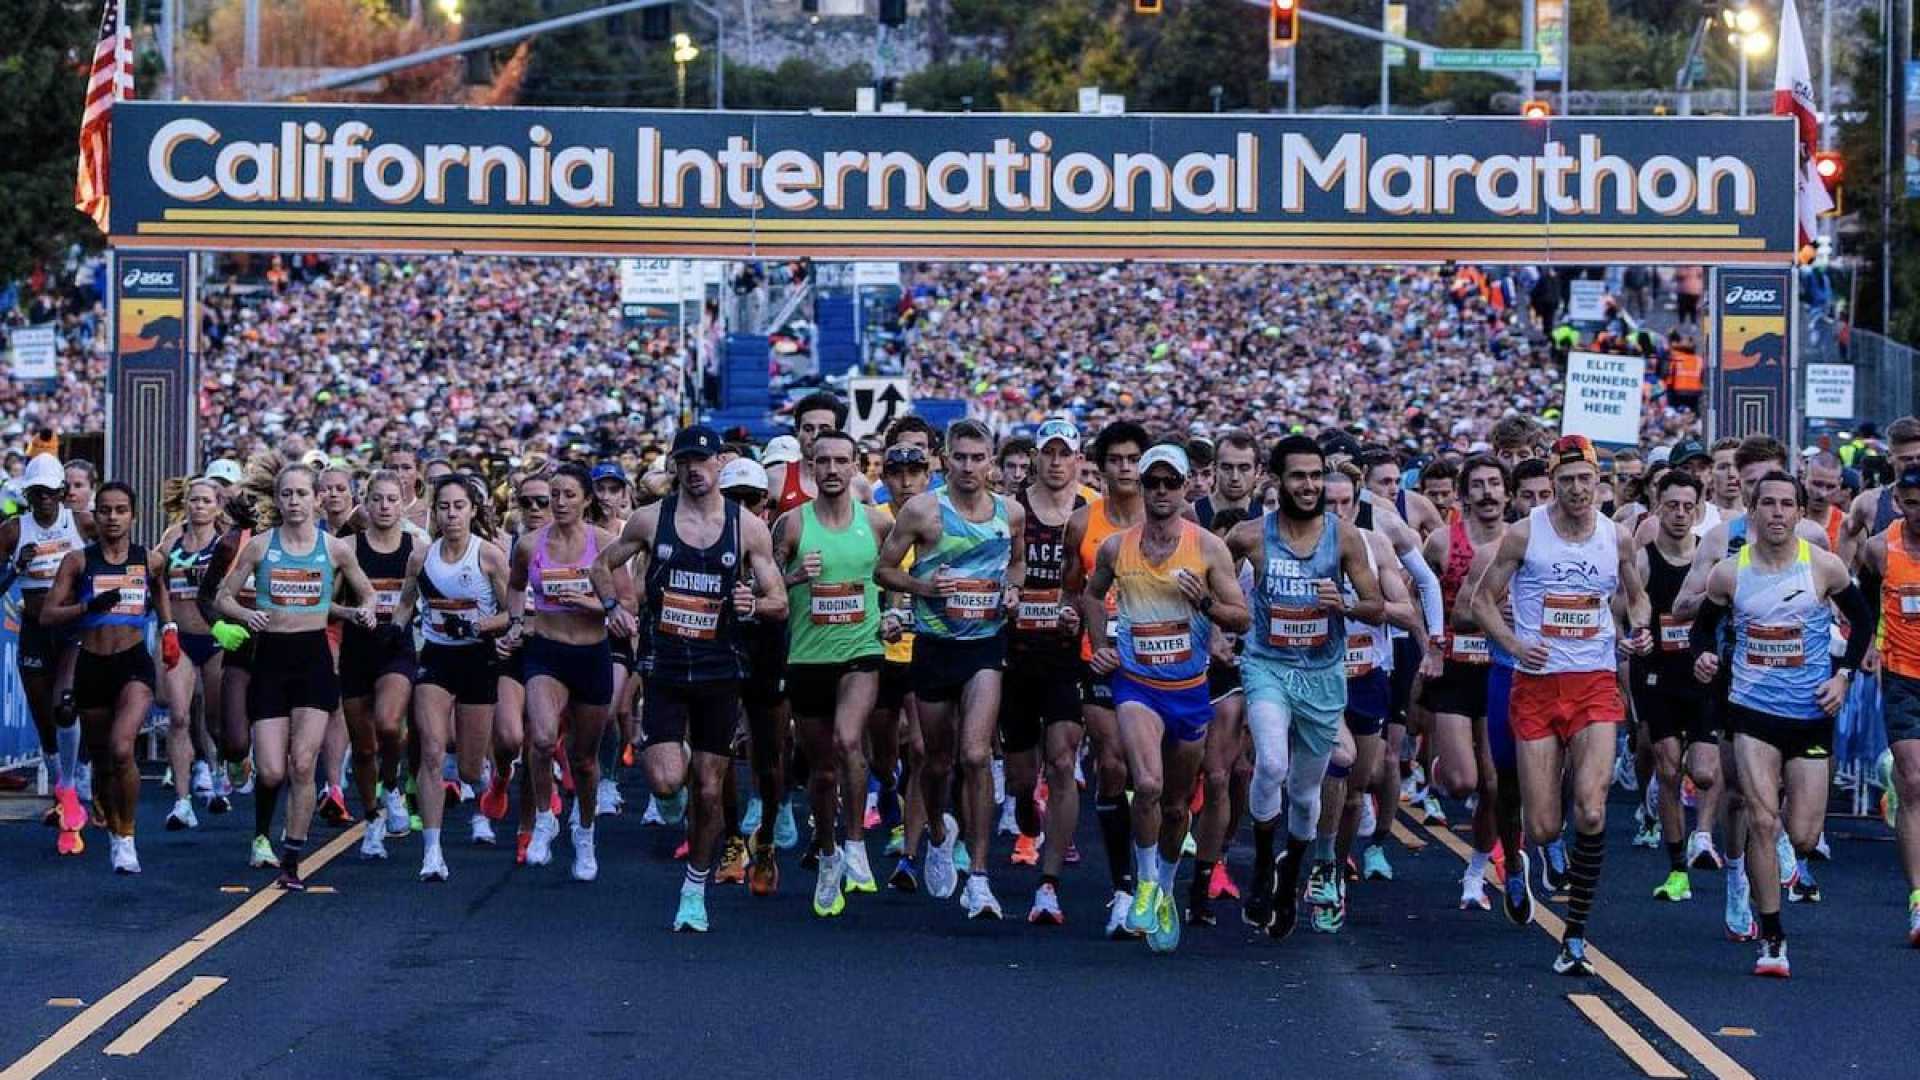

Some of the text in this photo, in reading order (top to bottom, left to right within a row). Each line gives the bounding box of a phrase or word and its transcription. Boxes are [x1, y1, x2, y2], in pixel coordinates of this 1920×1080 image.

[148, 118, 1755, 216] California International Marathon
[140, 271, 174, 285] asics
[1742, 289, 1776, 302] asics
[1587, 359, 1625, 372] ELITE
[1571, 372, 1639, 388] RUNNERS
[1581, 387, 1627, 401] ENTER
[1583, 401, 1622, 415] HERE
[1268, 559, 1301, 576] FREE
[271, 583, 321, 593] GOODMAN
[953, 593, 994, 607] ROESER
[663, 609, 716, 626] SWEENEY
[1553, 611, 1592, 625] GREGG
[1284, 623, 1317, 635] HREZI
[1138, 638, 1185, 652] BAXTER
[1748, 642, 1802, 654] ALBERTSON
